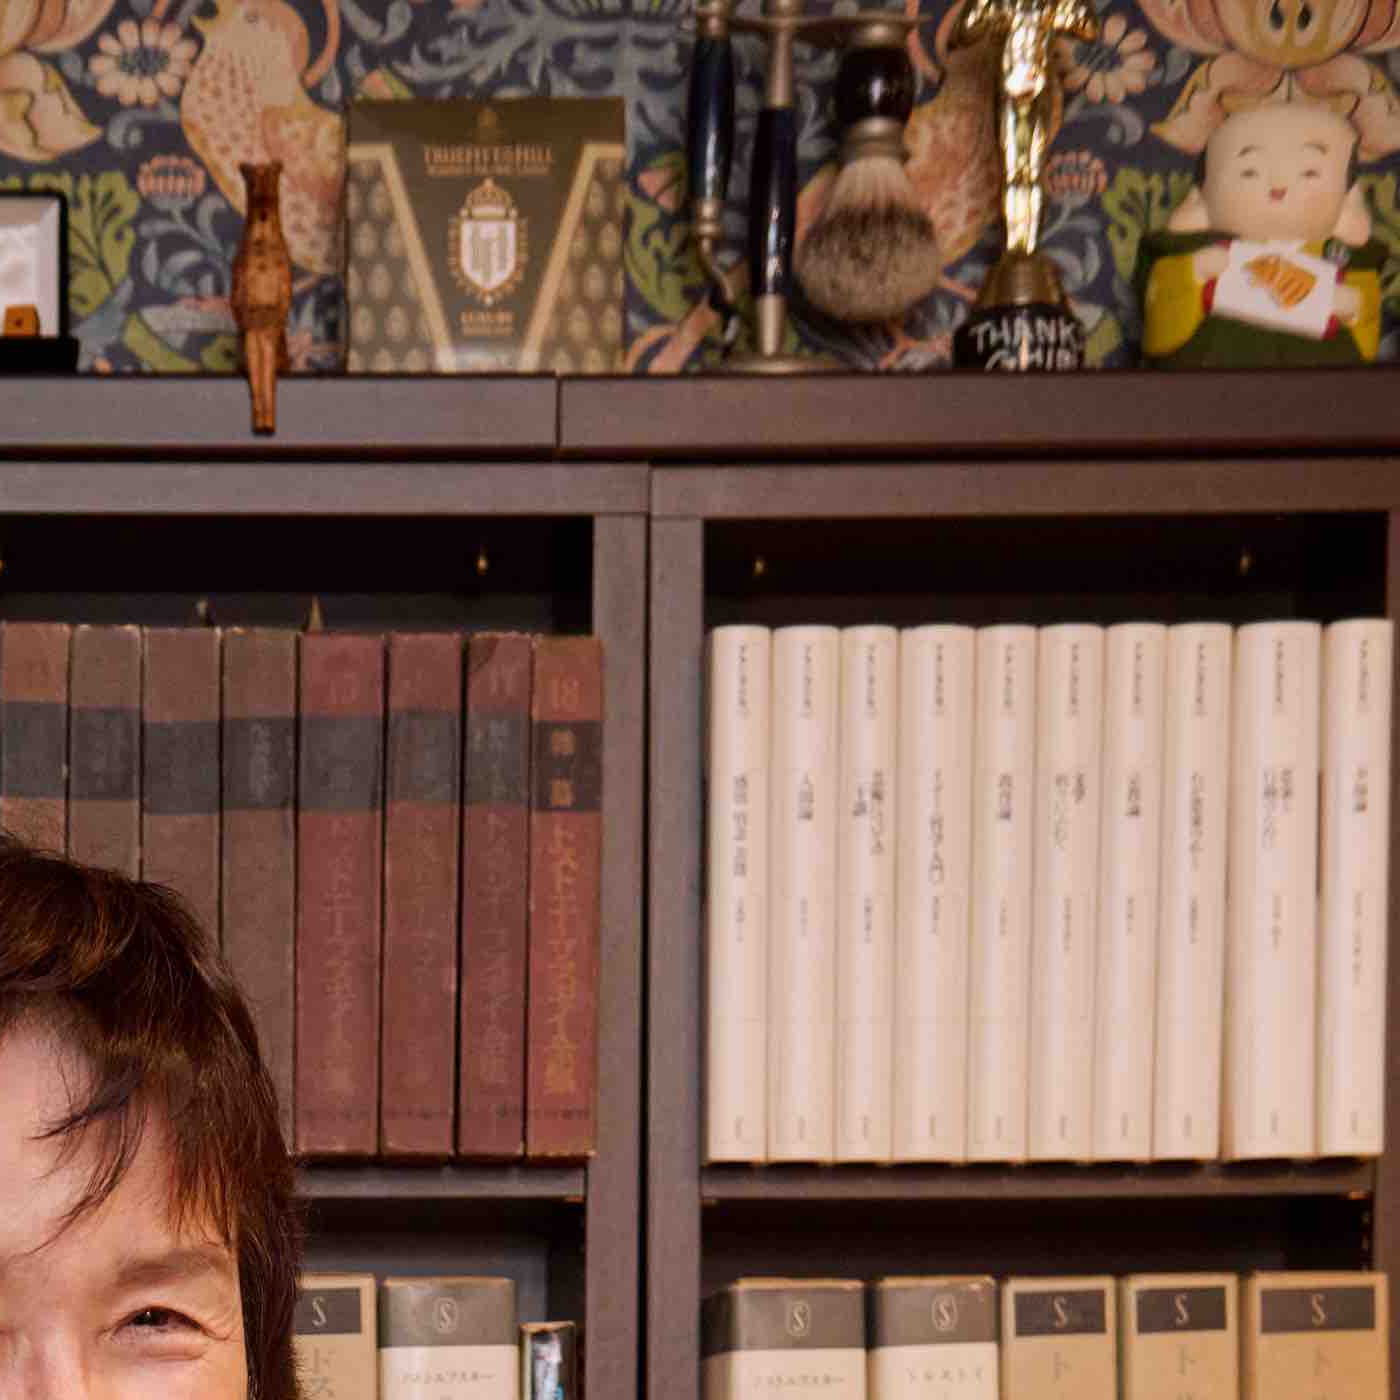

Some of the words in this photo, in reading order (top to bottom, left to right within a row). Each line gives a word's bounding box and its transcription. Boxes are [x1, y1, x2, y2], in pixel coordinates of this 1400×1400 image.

[552, 678, 582, 708] 18
[311, 1301, 327, 1329] S
[1053, 1298, 1070, 1327] S
[1174, 1292, 1191, 1325] S
[1309, 1293, 1326, 1325] S
